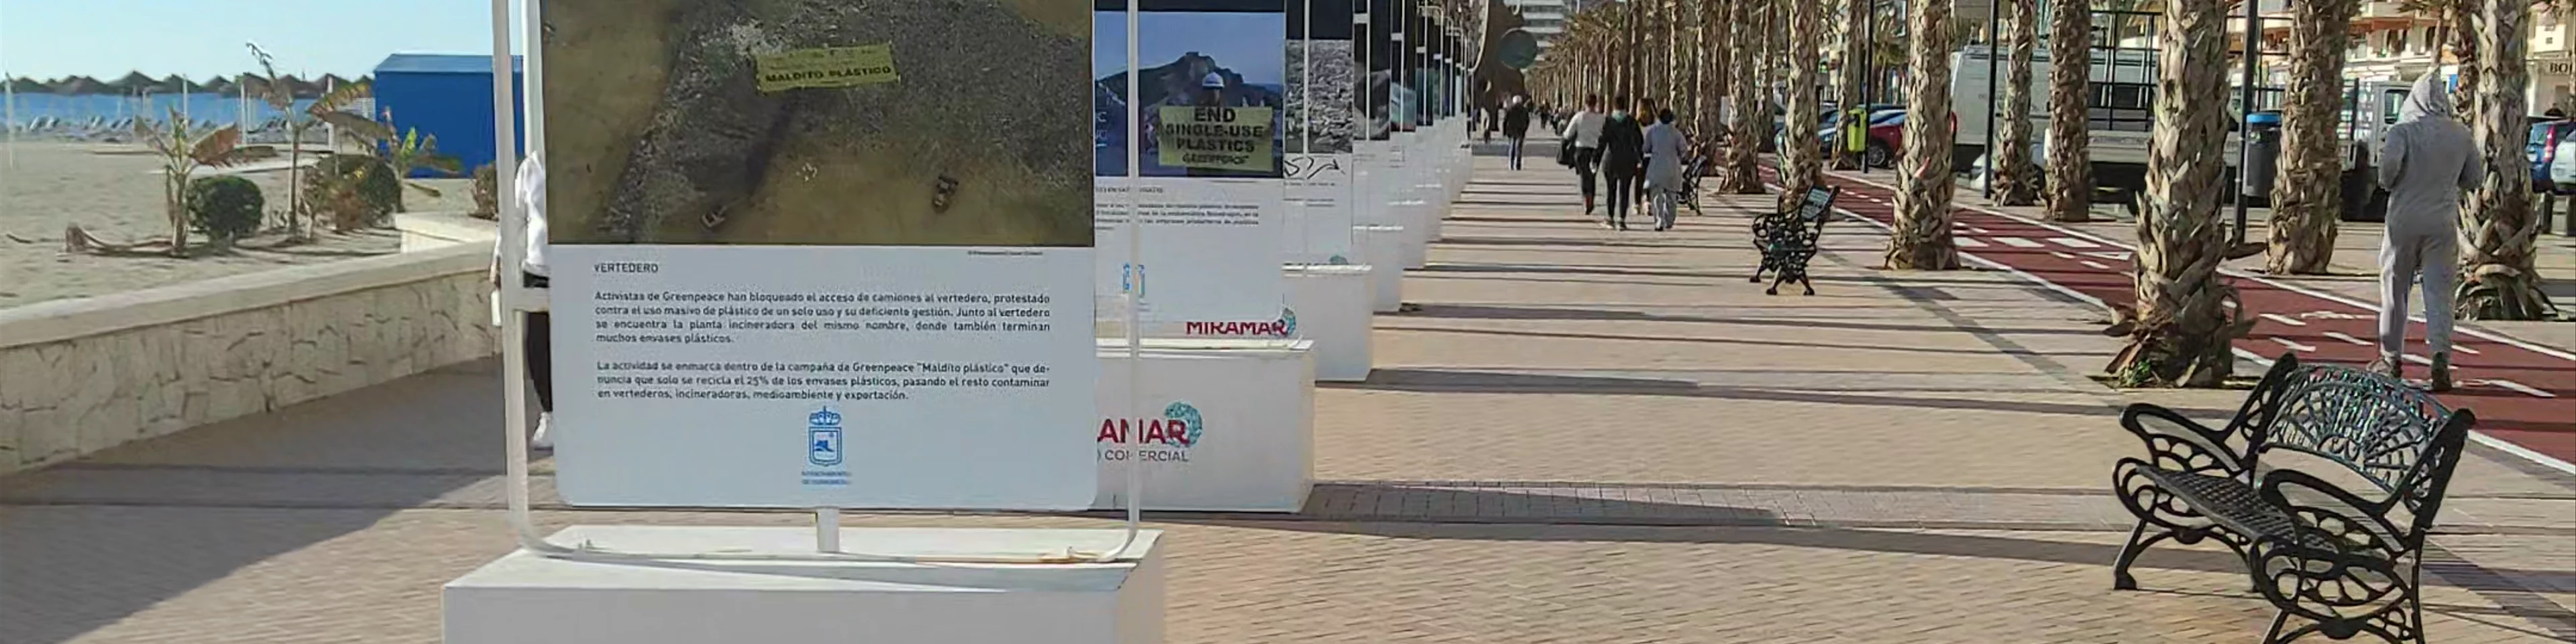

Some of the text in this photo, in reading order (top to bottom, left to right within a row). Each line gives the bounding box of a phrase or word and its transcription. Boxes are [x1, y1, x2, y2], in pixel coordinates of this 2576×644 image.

[765, 70, 824, 83] MALDITO
[1194, 107, 1236, 123] END
[1166, 123, 1263, 138] SINGLE-USE
[1177, 138, 1255, 153] PLASTICS
[594, 263, 659, 273] VERTEDERO
[594, 291, 645, 301] Activistas
[647, 291, 661, 302] de
[662, 292, 725, 304] Greenpeace
[727, 292, 747, 302] han
[749, 292, 805, 304] bloqueado
[806, 292, 818, 303] el
[818, 294, 855, 303] acceso
[857, 292, 870, 303] de
[871, 292, 922, 303] camiones
[924, 293, 935, 303] al
[993, 293, 1051, 305] protestado
[594, 306, 631, 316] contra
[631, 306, 642, 316] el
[643, 308, 663, 316] uso
[663, 306, 702, 316] masivo
[702, 306, 716, 317] de
[718, 306, 759, 319] plástico
[761, 306, 774, 317] de
[775, 308, 790, 317] un
[791, 306, 814, 317] solo
[815, 309, 835, 317] uso
[836, 309, 843, 319] y
[844, 309, 857, 317] su
[955, 307, 985, 317] Junto
[987, 307, 998, 317] al
[999, 307, 1051, 317] vertedero
[595, 321, 608, 330] se
[613, 319, 667, 330] encuentra
[672, 319, 684, 330] la
[689, 319, 722, 332] planta
[728, 320, 796, 331] incineradora
[800, 320, 818, 331] del
[823, 320, 861, 331] mismo
[915, 321, 948, 331] donde
[1002, 321, 1051, 331] terminan
[1186, 321, 1288, 336] MIRAMAR
[595, 333, 637, 343] muchos
[638, 335, 683, 343] envases
[596, 361, 610, 371] La
[611, 361, 659, 371] actividad
[660, 363, 674, 372] se
[674, 363, 722, 372] enmarca
[723, 362, 759, 372] dentro
[760, 362, 774, 372] de
[775, 362, 786, 372] la
[787, 362, 835, 374] campaña
[837, 362, 850, 372] de
[852, 362, 916, 375] Greenpeace
[1010, 365, 1031, 376] que
[634, 377, 654, 387] que
[656, 375, 679, 386] solo
[681, 377, 694, 386] se
[696, 375, 732, 386] recicla
[734, 375, 746, 386] el
[746, 376, 769, 386] 25%
[771, 376, 785, 386] de
[786, 376, 803, 386] los
[805, 378, 848, 386] envases
[902, 376, 947, 388] pasando
[949, 376, 960, 387] el
[961, 376, 989, 387] resto
[991, 376, 1050, 388] contaminar
[597, 390, 611, 399] en
[752, 389, 834, 400] medioambiente
[835, 391, 843, 402] y
